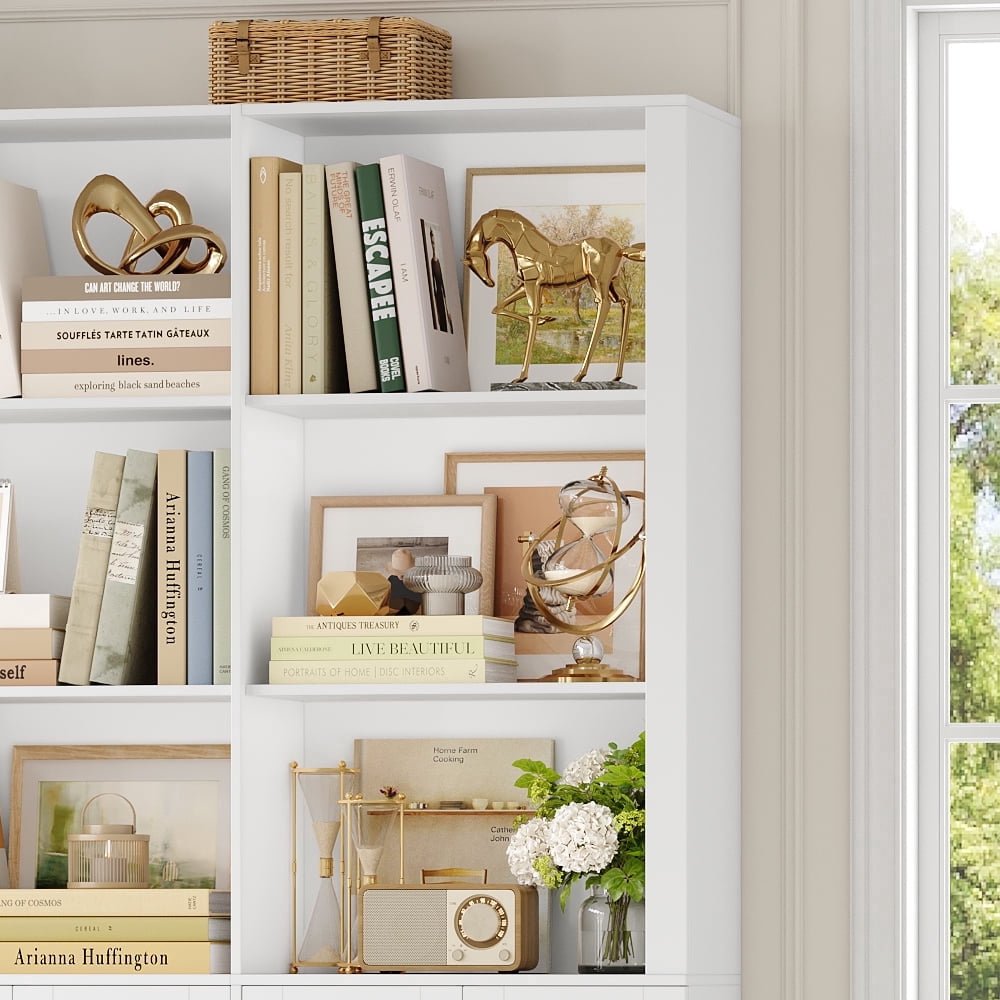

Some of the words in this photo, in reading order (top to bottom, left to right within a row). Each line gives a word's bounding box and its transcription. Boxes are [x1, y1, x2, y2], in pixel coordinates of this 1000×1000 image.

[335, 172, 344, 201] MINDS
[342, 171, 350, 187] THE
[387, 167, 398, 197] ERWIN
[392, 199, 401, 222] OLAF
[361, 217, 396, 322] ESCAPEE
[84, 282, 98, 294] CAN
[99, 282, 112, 293] ART
[113, 281, 139, 293] CHANGE
[140, 281, 152, 292] THE
[153, 280, 181, 292] WORLD?
[184, 305, 212, 313] LIFE
[56, 328, 101, 340] SOUFFLÉS
[104, 330, 133, 339] TARTE
[135, 330, 163, 339] TATIN
[166, 327, 210, 338] GÂTEAUX
[117, 355, 155, 366] lines.
[389, 356, 401, 380] COVEL
[379, 359, 391, 382] BOOKS
[74, 382, 116, 392] exploring
[118, 380, 142, 390] black
[143, 380, 164, 389] sand
[165, 379, 200, 389] beaches
[222, 466, 230, 490] GANG
[222, 491, 230, 503] OF
[166, 492, 181, 553] Arianna
[222, 504, 230, 539] COSMOS
[161, 559, 181, 645] Huffington
[316, 621, 357, 631] ANTIQUES
[359, 621, 400, 630] TREASURY
[352, 642, 385, 655] LIVE
[389, 642, 475, 655] BEAUTIFUL
[283, 668, 326, 677] PORTRAITS
[330, 668, 342, 677] OF
[345, 667, 370, 677] HOME
[401, 667, 445, 676] INTERIORS
[433, 746, 456, 754] Home
[458, 746, 478, 754] Farm
[433, 755, 464, 764] Cooking
[14, 899, 26, 907] OF
[27, 899, 62, 907] COSMOS
[14, 948, 75, 966] Arianna
[82, 948, 168, 972] Huffington
